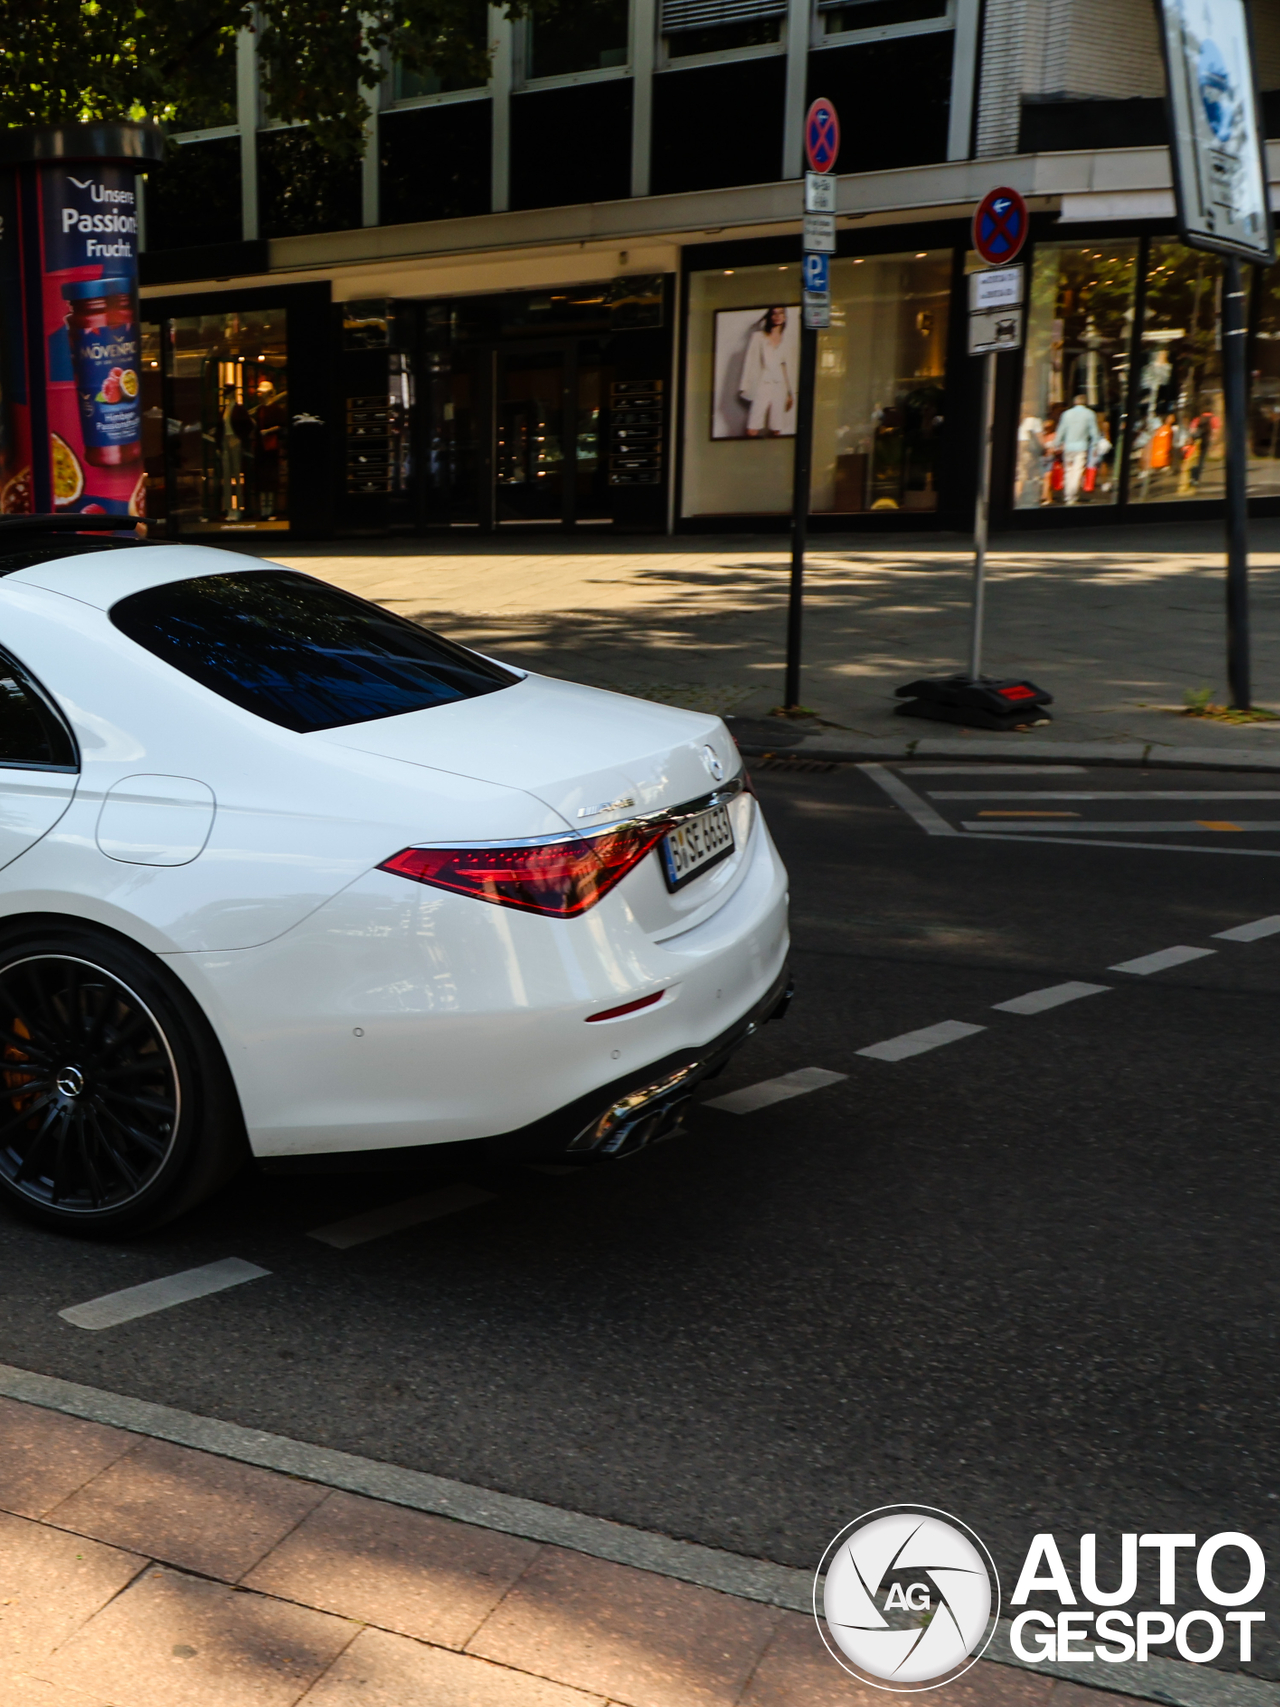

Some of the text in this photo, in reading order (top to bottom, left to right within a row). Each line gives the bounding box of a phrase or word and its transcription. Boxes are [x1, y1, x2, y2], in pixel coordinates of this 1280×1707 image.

[90, 184, 135, 203] Unsere
[86, 239, 133, 257] Frucht.
[807, 255, 823, 286] P
[670, 807, 729, 872] B SE 6633
